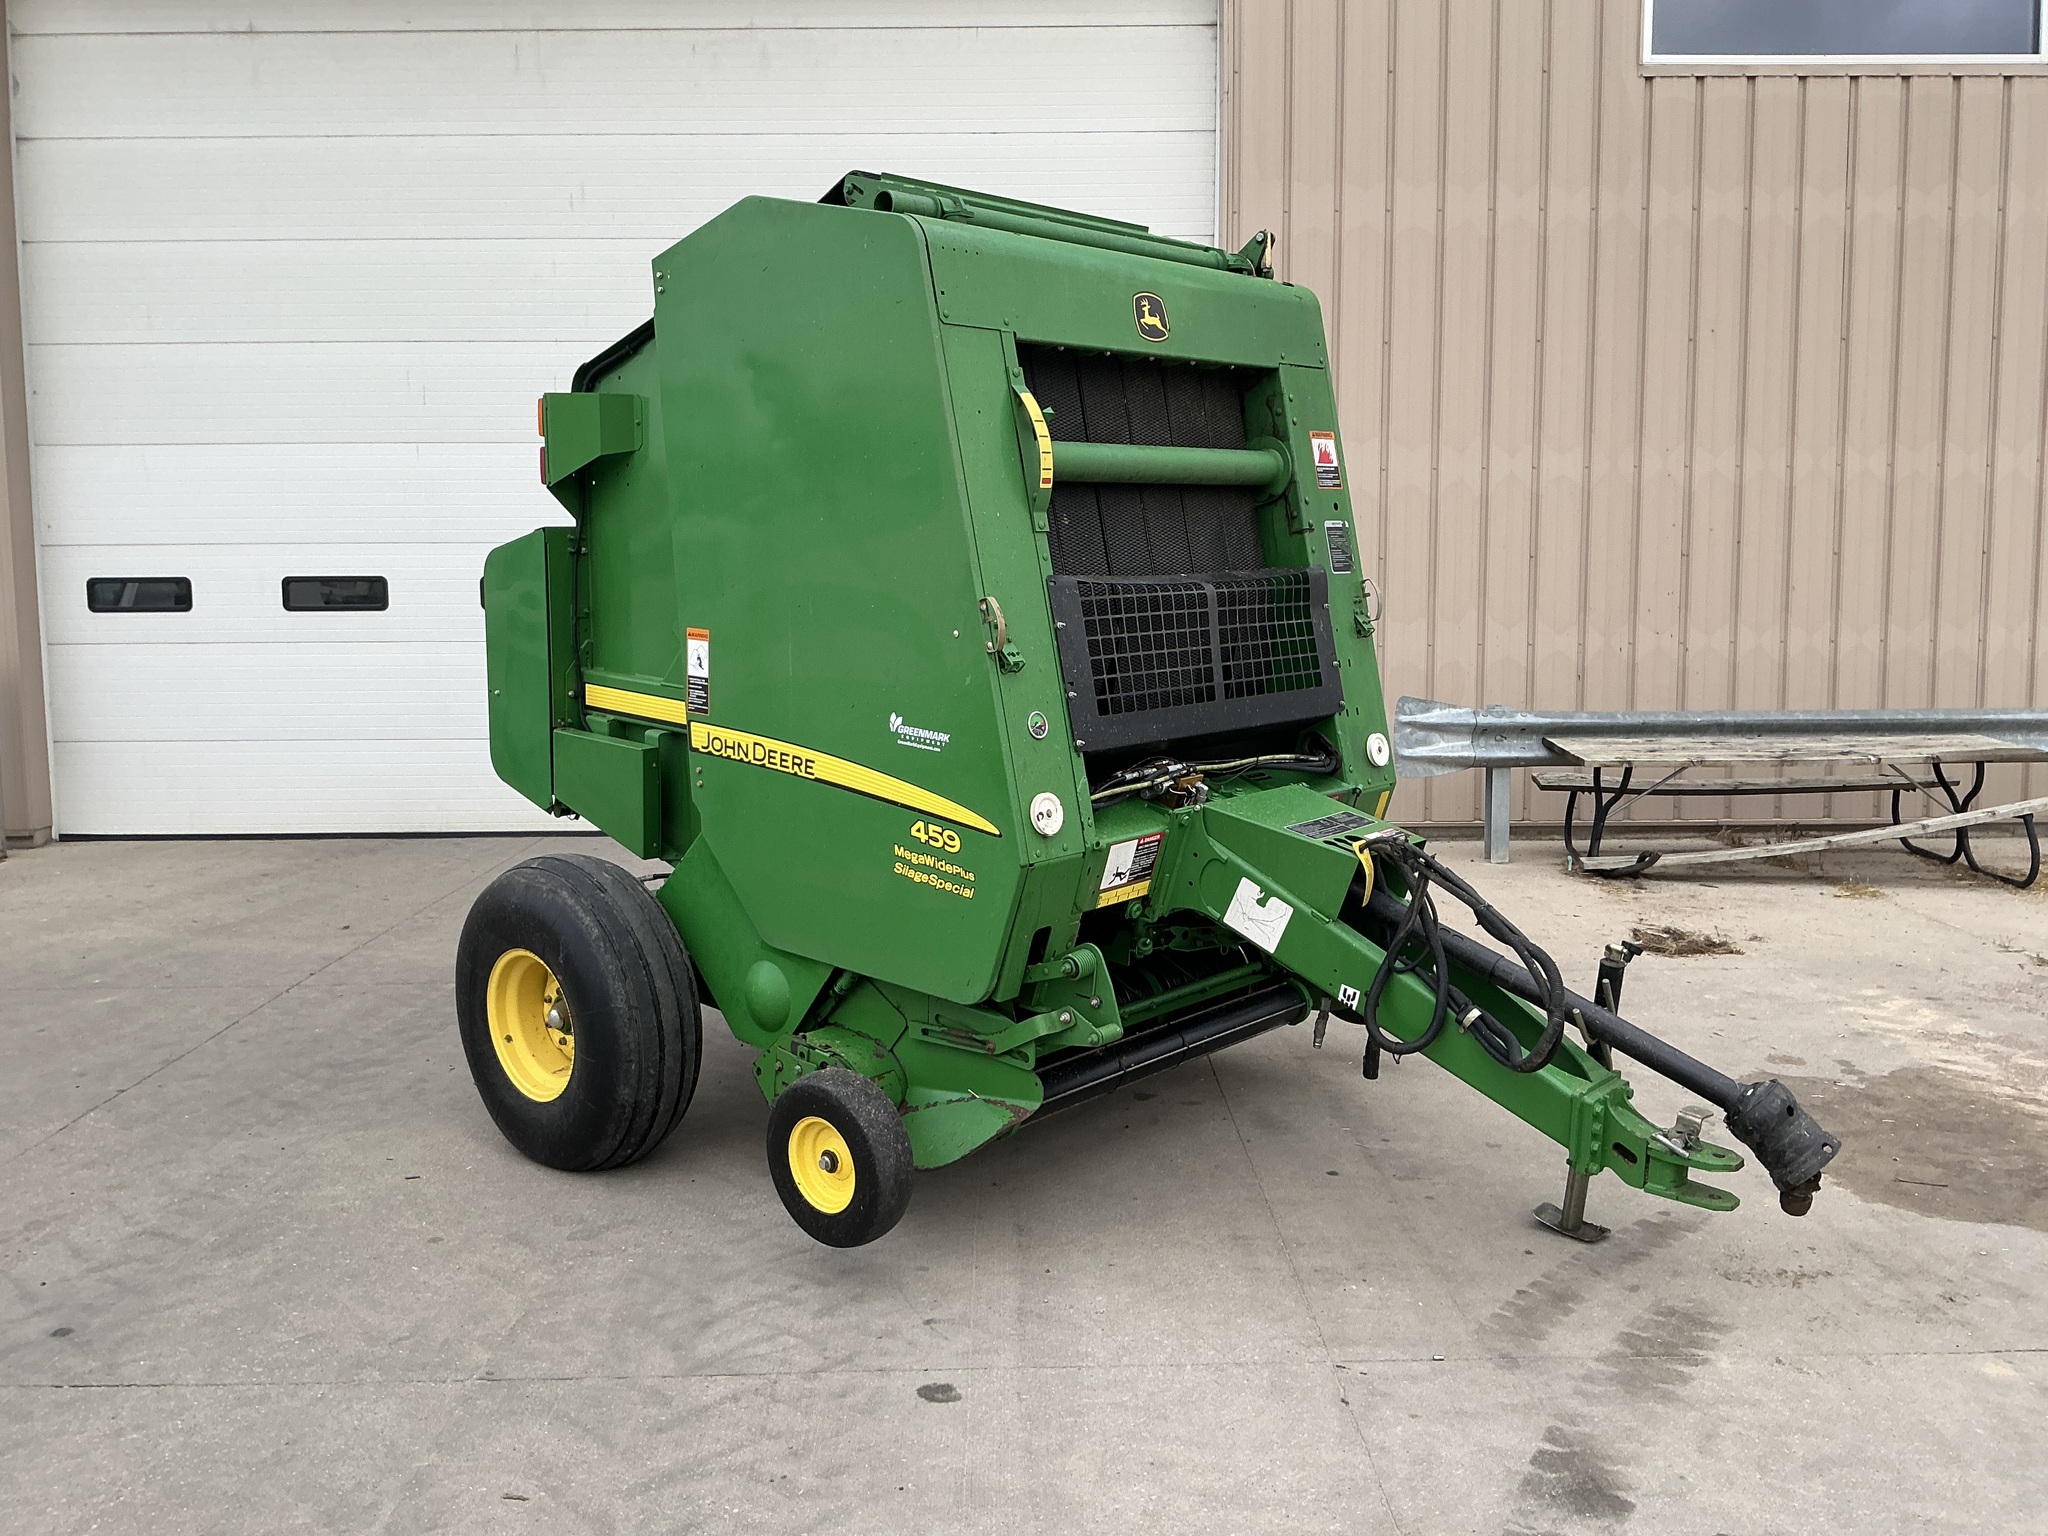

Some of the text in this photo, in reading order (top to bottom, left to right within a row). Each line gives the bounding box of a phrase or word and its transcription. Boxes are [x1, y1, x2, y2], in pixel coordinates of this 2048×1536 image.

[897, 725, 951, 743] GREENMARK
[901, 734, 946, 747] EQUIPMENT
[701, 731, 816, 776] JOHN DEERE
[910, 820, 961, 854] 459
[1144, 834, 1161, 842] DANGER
[893, 844, 976, 882] MegaWidePlus
[893, 862, 975, 900] SilageSpecial
